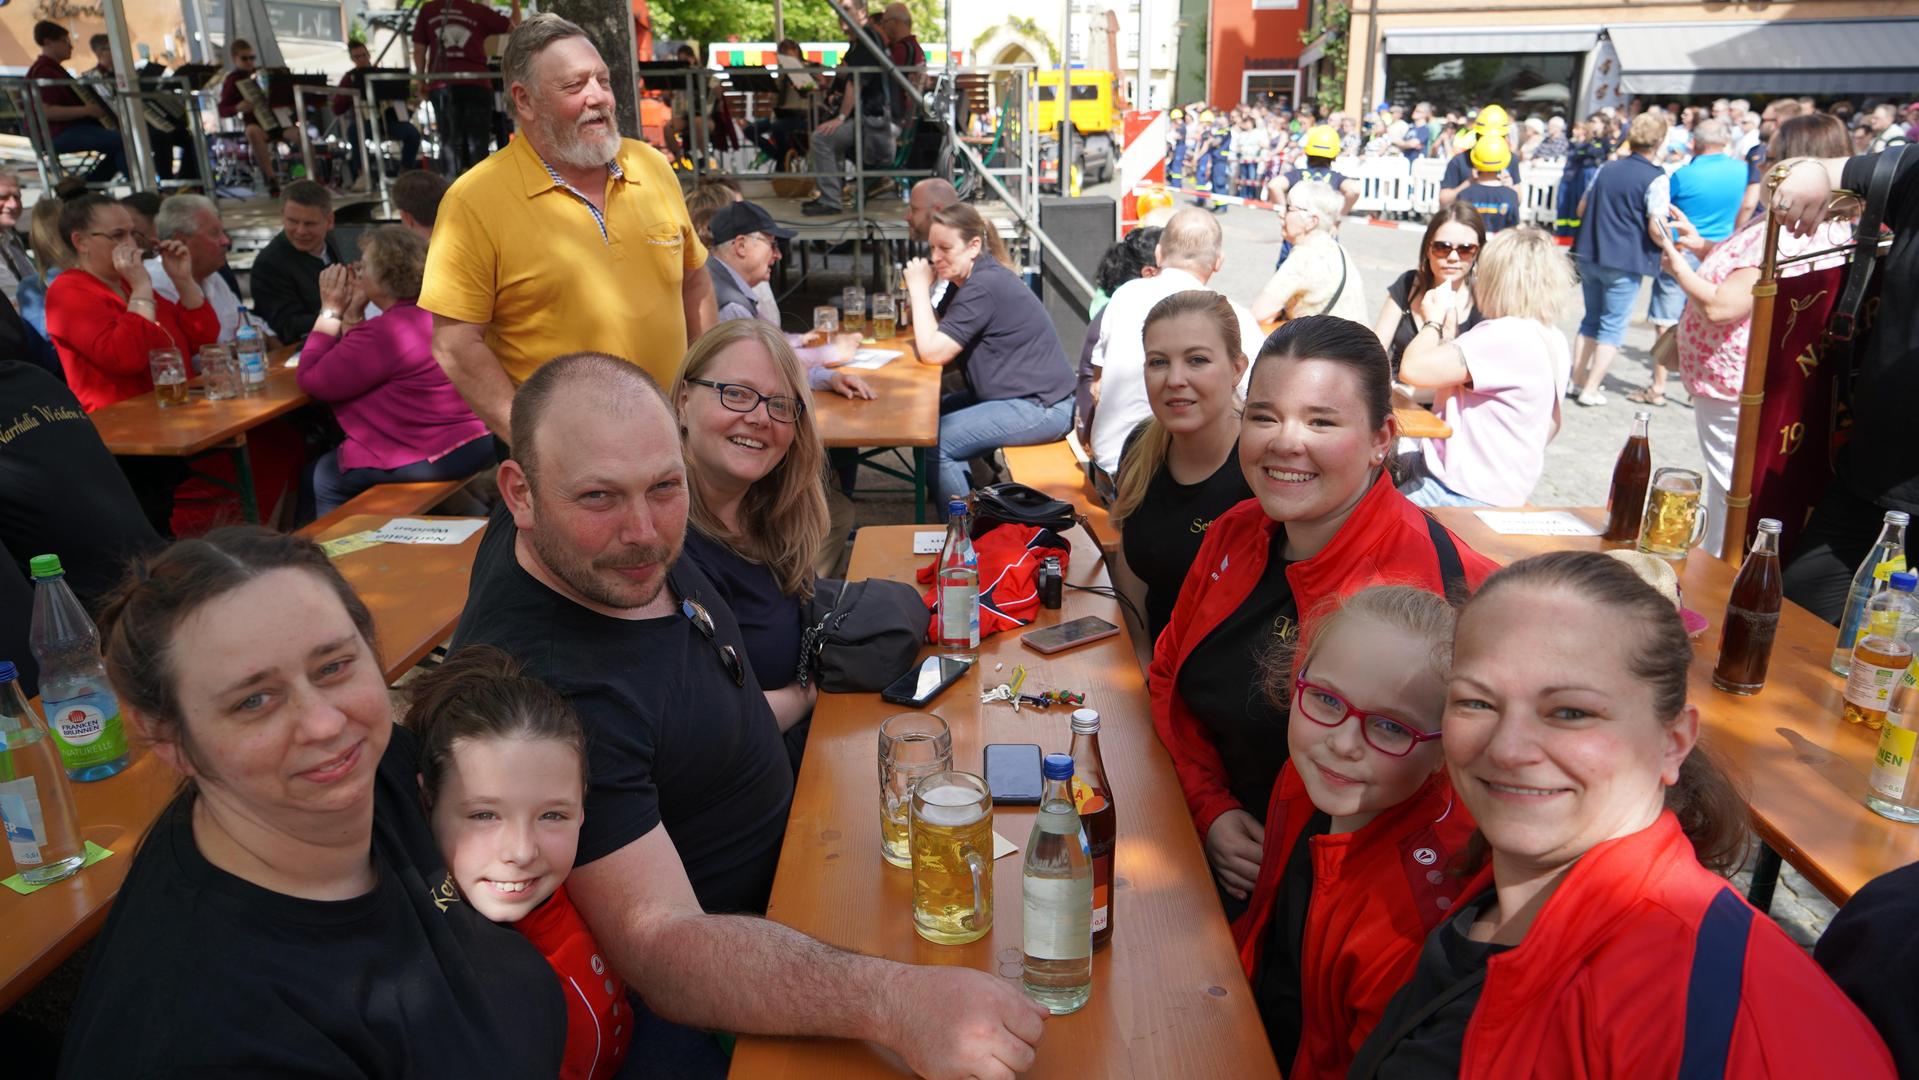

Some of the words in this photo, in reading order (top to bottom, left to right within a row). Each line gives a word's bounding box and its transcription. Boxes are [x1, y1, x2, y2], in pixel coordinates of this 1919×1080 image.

[1779, 421, 1805, 456] 19
[62, 720, 98, 731] FRANKEN
[63, 725, 100, 736] BRUNNEN
[63, 743, 113, 756] NATURELLE
